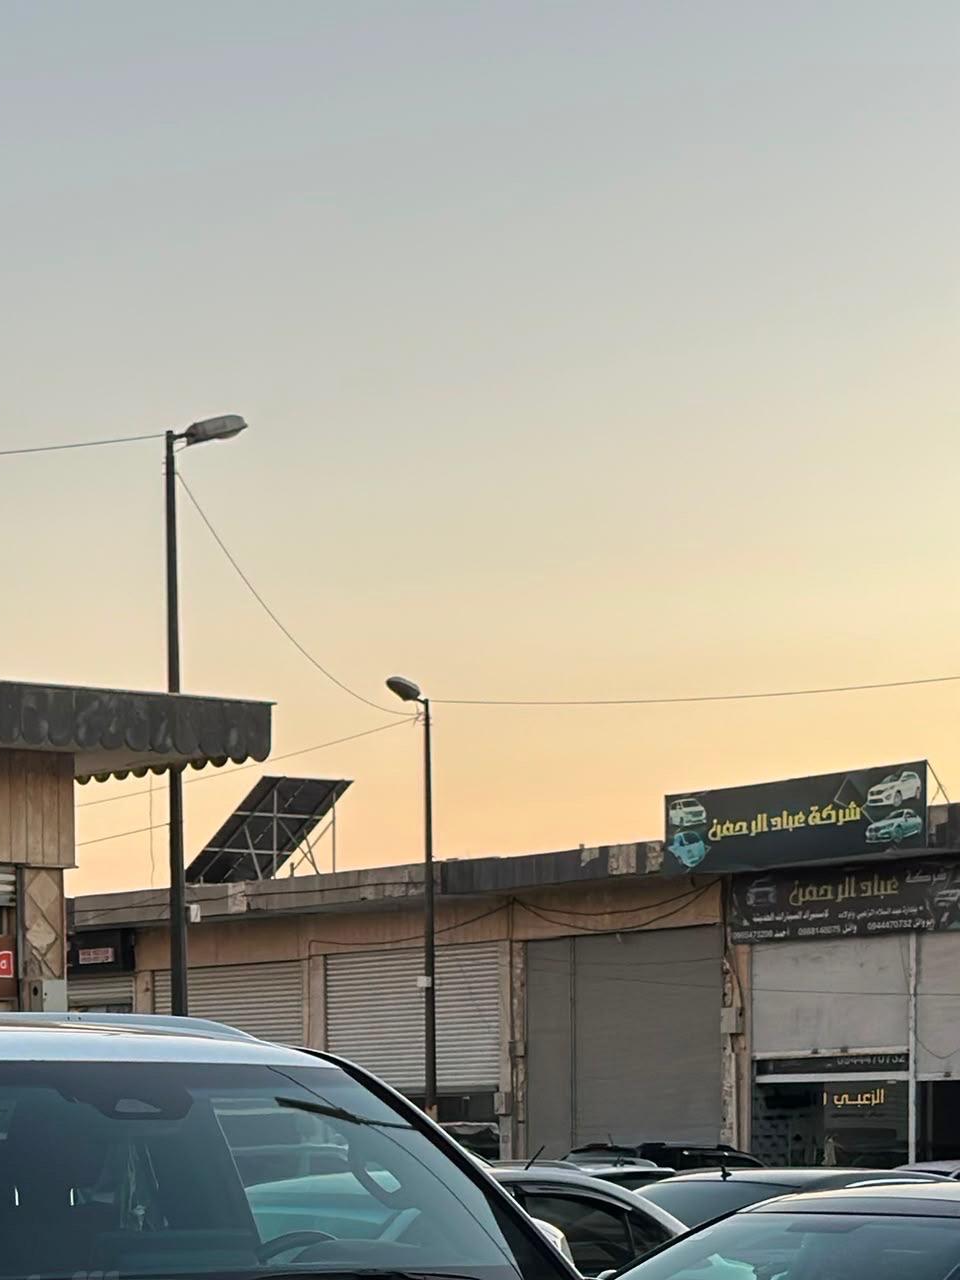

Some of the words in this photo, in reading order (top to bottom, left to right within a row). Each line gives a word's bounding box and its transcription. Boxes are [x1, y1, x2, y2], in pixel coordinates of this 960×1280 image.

[770, 810, 806, 832] عباد
[807, 801, 861, 826] شركة
[708, 813, 768, 841] الرحمن
[833, 1088, 884, 1107] الزعبي
